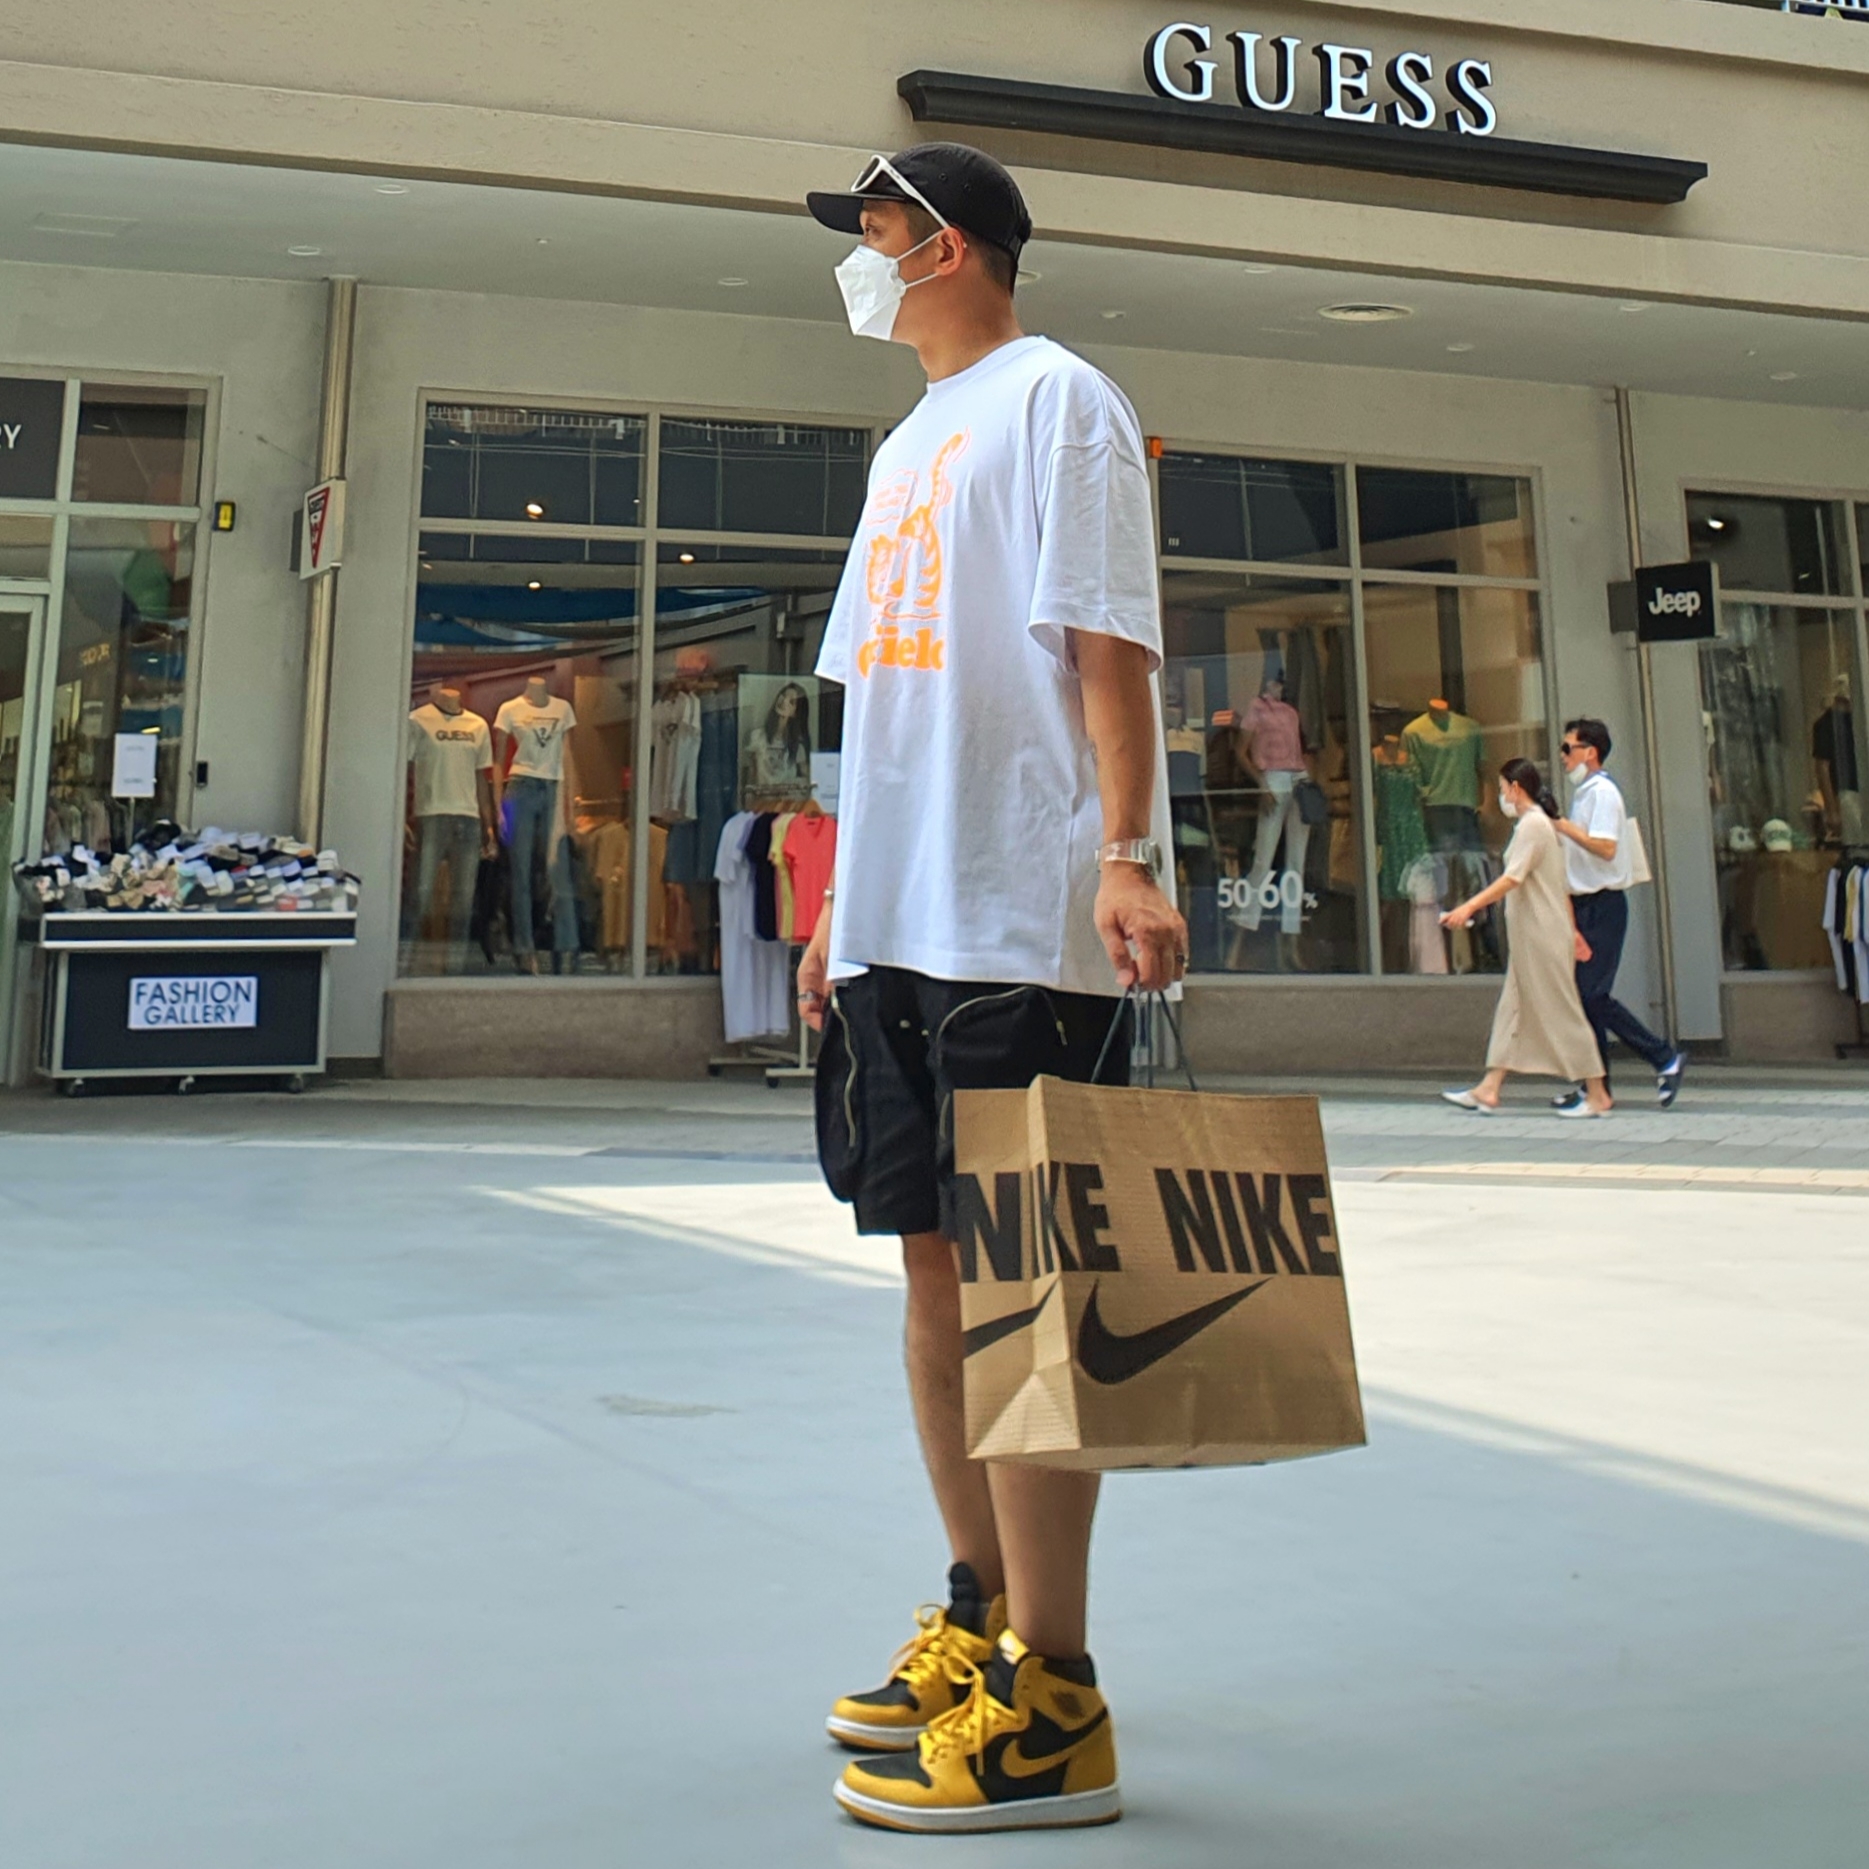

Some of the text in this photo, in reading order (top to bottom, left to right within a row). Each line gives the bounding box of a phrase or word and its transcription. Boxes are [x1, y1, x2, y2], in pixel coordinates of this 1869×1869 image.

[1146, 22, 1497, 136] GUESS
[1648, 586, 1701, 618] Jeep
[135, 980, 252, 1005] FASHION
[143, 1003, 240, 1025] GALLERY
[1153, 1167, 1343, 1277] NIKE
